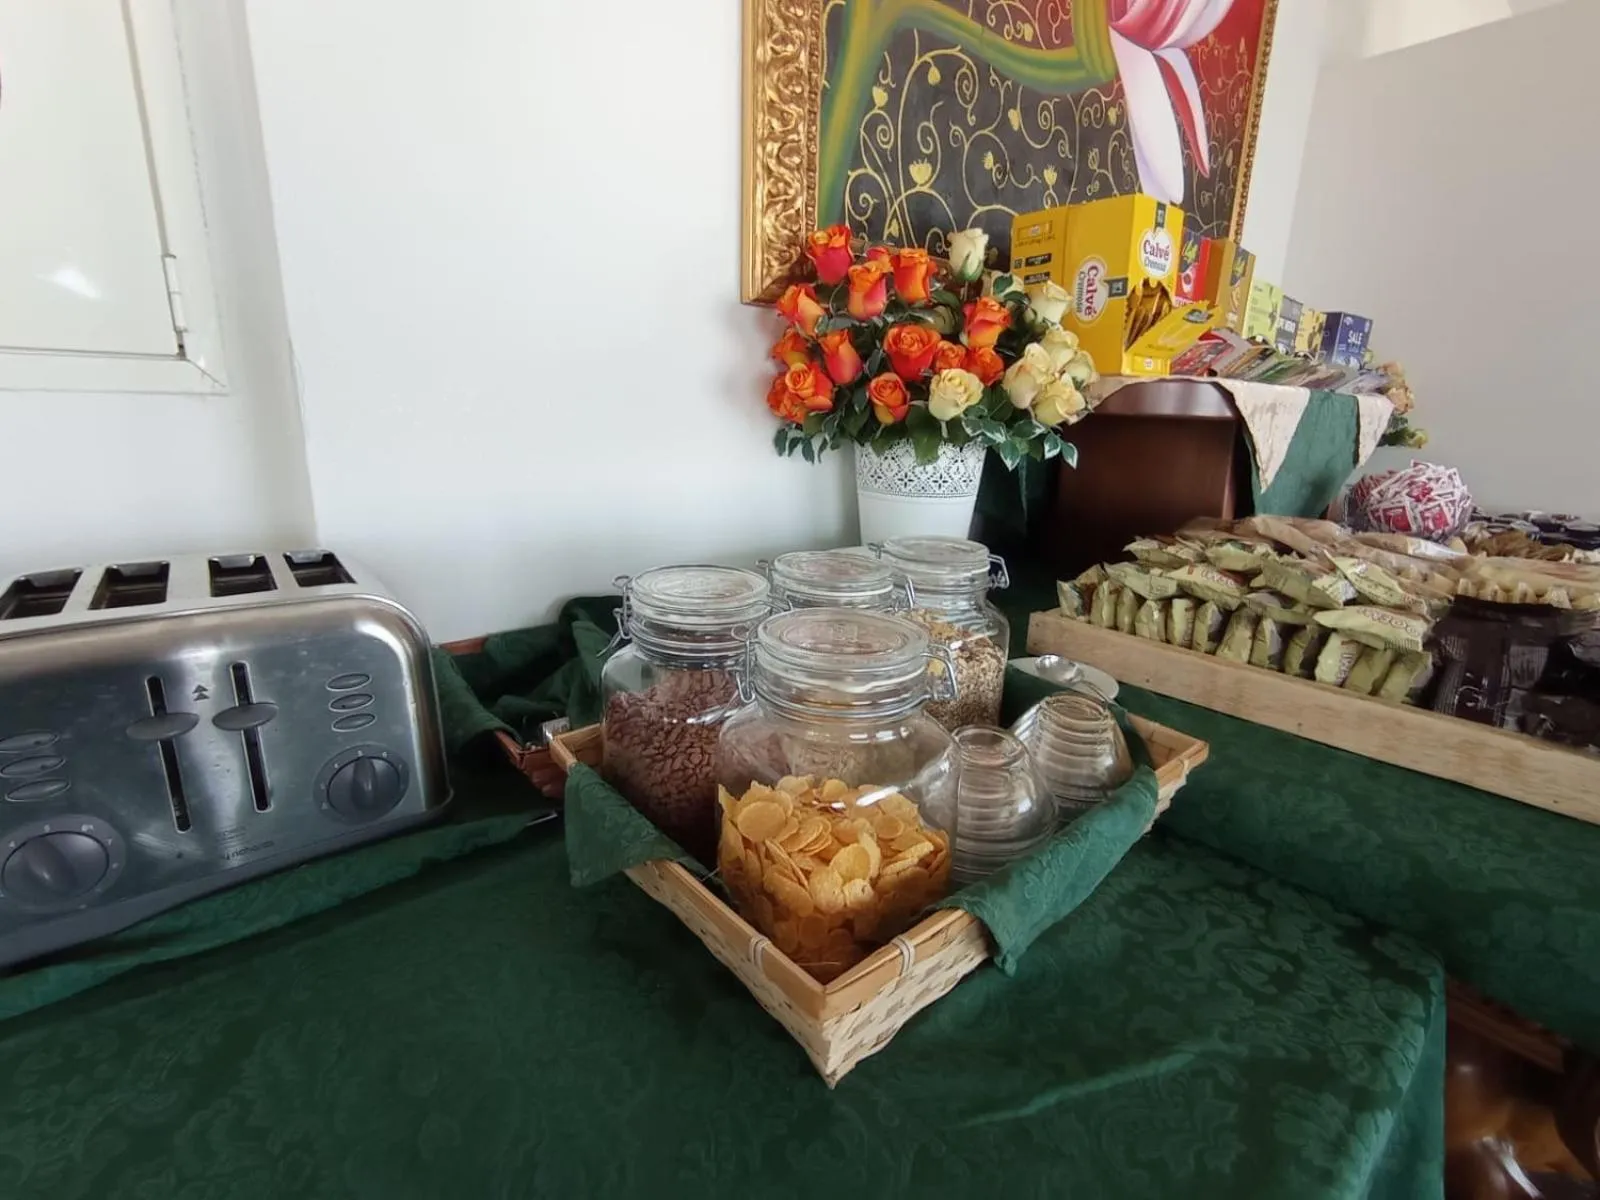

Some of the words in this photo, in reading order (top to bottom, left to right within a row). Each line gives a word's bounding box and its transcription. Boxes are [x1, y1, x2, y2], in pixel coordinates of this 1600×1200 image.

[1143, 239, 1170, 261] Calvé
[1084, 265, 1099, 317] Calvé
[1347, 329, 1363, 345] SALE
